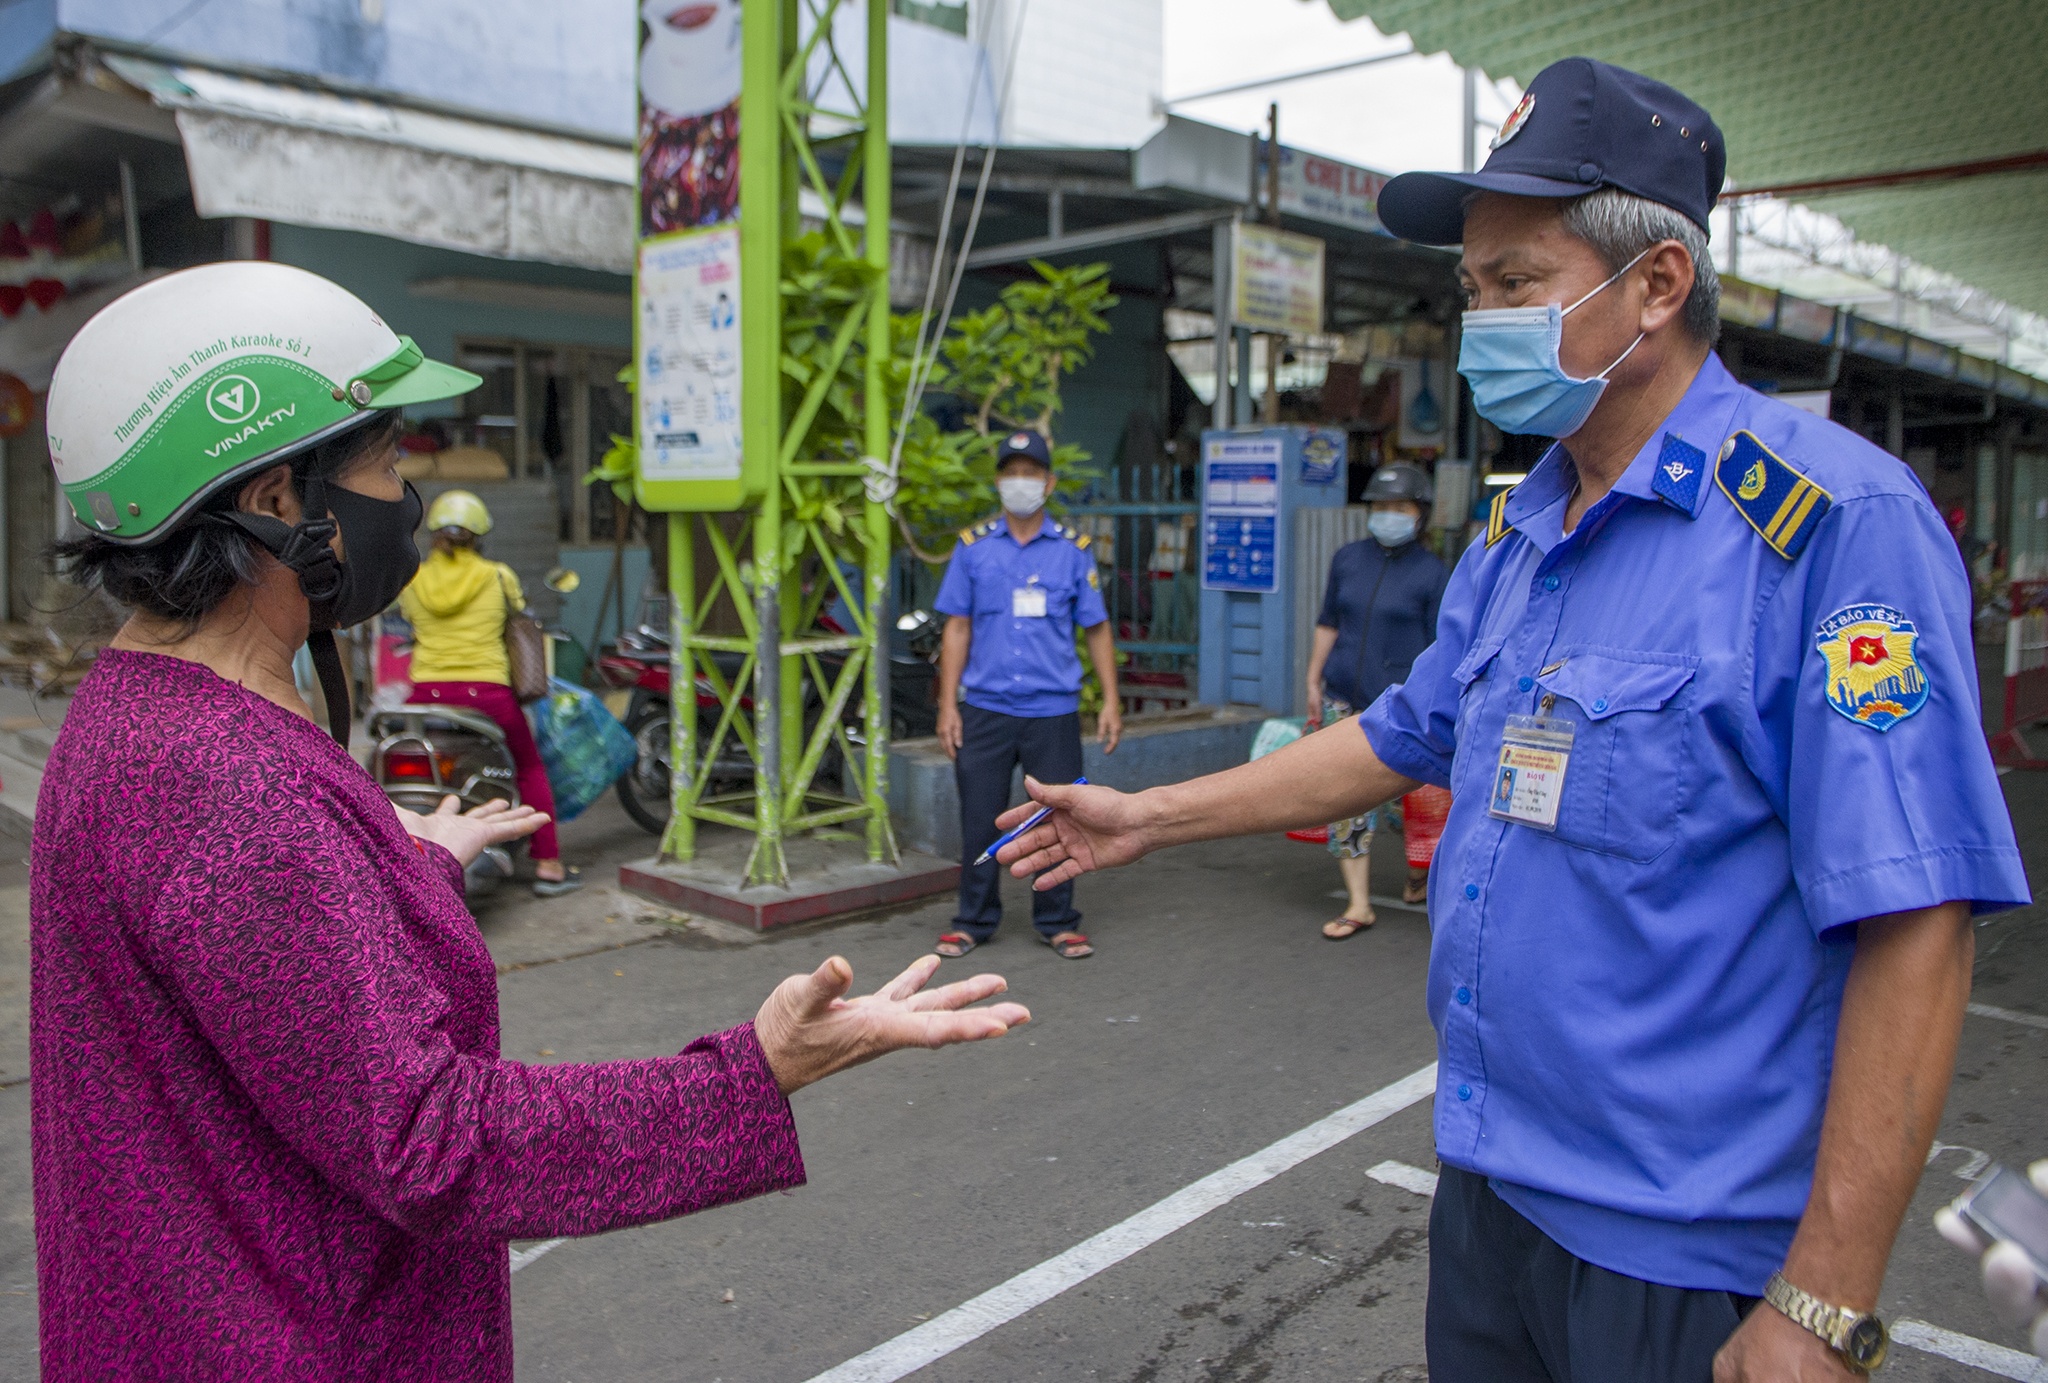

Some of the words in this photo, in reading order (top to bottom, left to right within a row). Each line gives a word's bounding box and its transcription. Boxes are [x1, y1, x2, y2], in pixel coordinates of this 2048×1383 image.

[113, 404, 154, 443] Thương
[148, 380, 174, 407] Hiệu
[168, 361, 192, 383] Âm
[189, 338, 228, 367] Thanh
[230, 333, 283, 349] Karaoke
[286, 337, 301, 354] Số
[303, 346, 312, 358] 1
[204, 402, 296, 458] VINAKTV
[1838, 609, 1864, 625] BẢO
